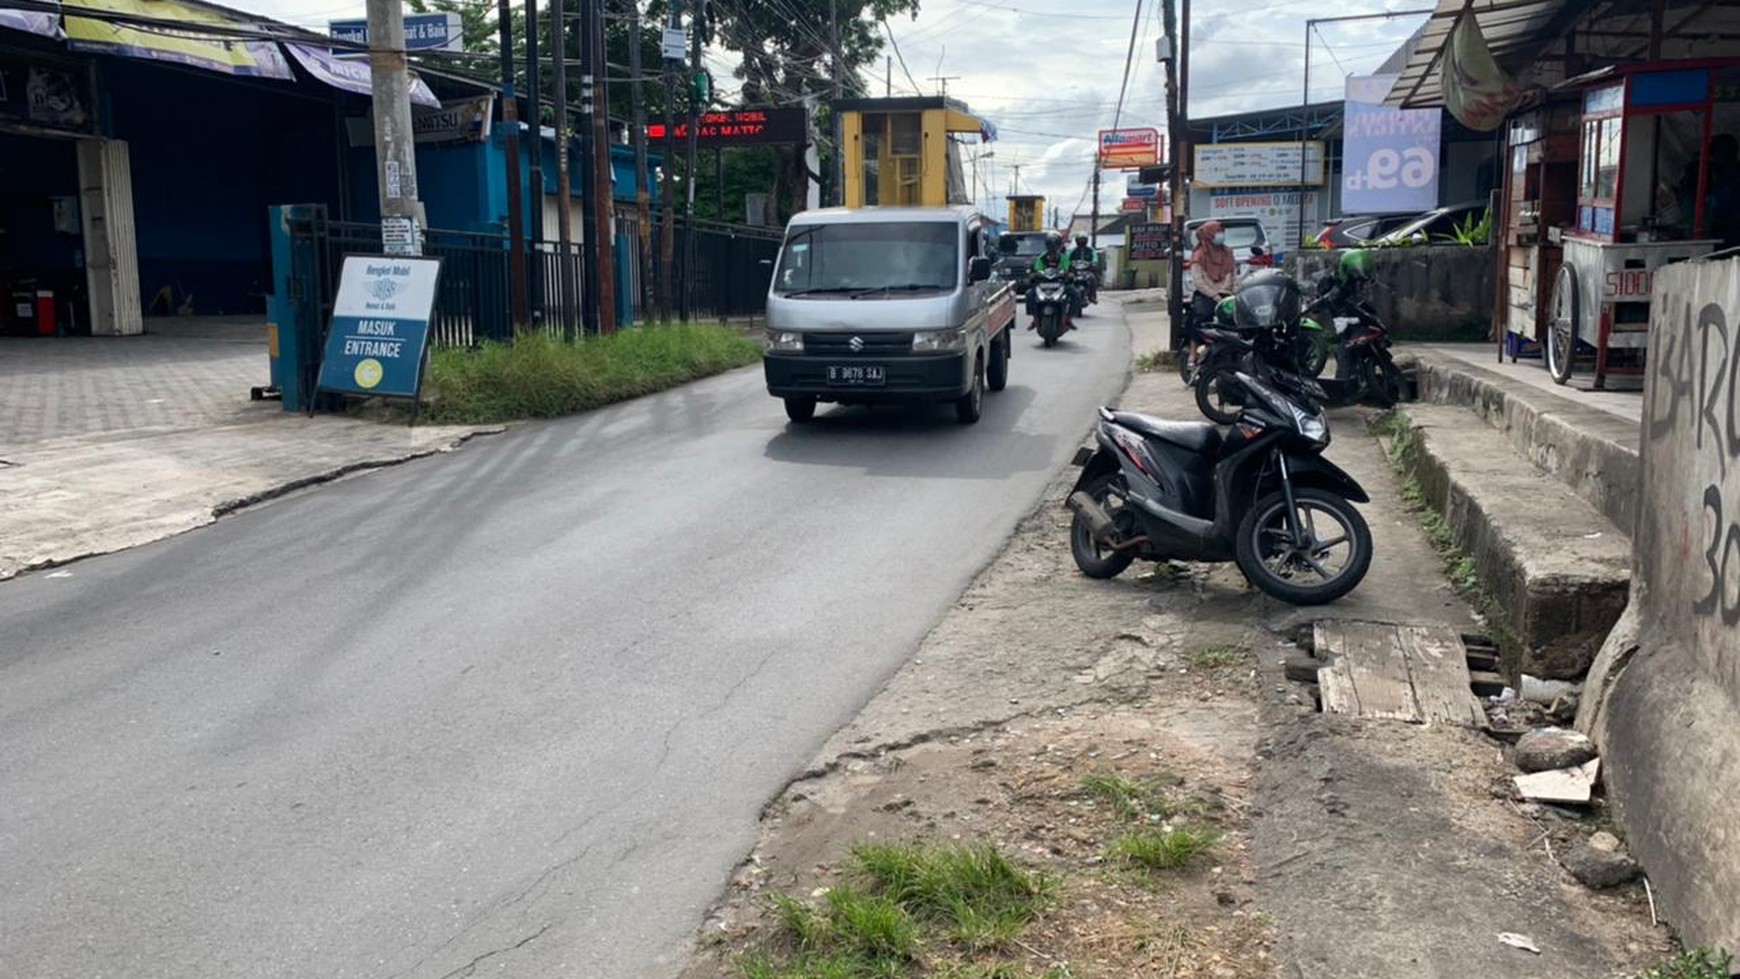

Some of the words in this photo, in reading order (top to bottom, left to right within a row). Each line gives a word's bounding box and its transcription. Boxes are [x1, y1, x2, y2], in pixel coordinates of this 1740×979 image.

[418, 24, 426, 39] &
[1103, 133, 1152, 144] Alfamart
[357, 320, 396, 336] MASUK
[344, 340, 402, 358] ENTRANCE
[830, 367, 836, 379] B
